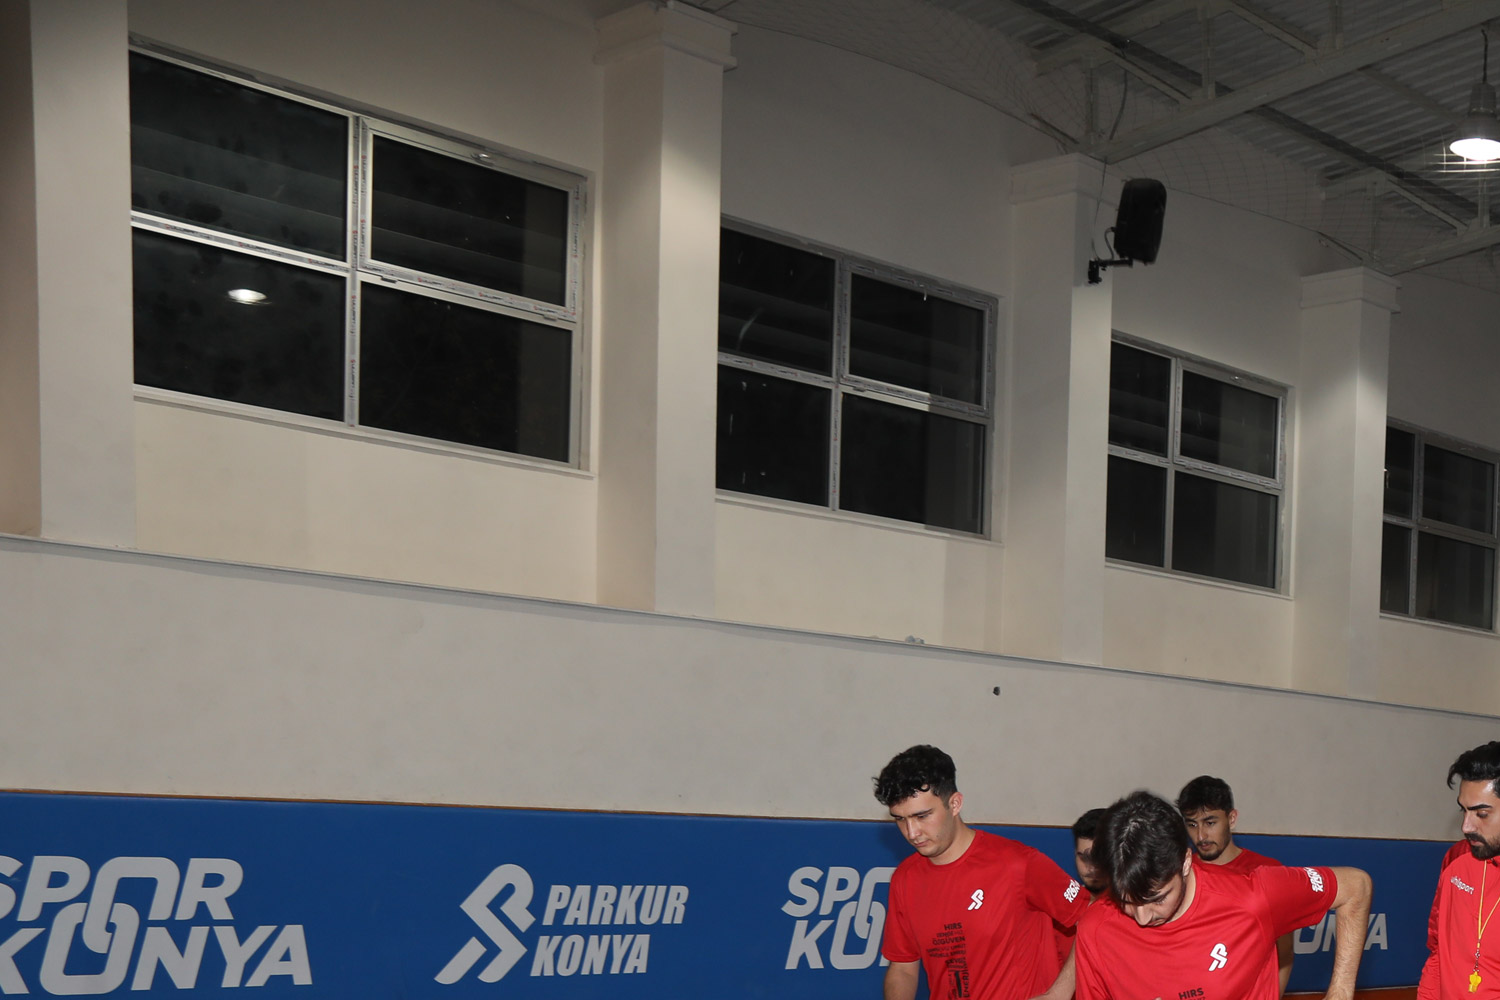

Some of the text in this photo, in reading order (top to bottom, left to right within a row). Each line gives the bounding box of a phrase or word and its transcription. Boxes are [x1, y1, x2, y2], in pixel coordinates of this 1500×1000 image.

[541, 884, 690, 926] PARKUR
[781, 866, 897, 939] SPO
[530, 934, 651, 978] KONYA
[1178, 988, 1204, 1000] HIRS
